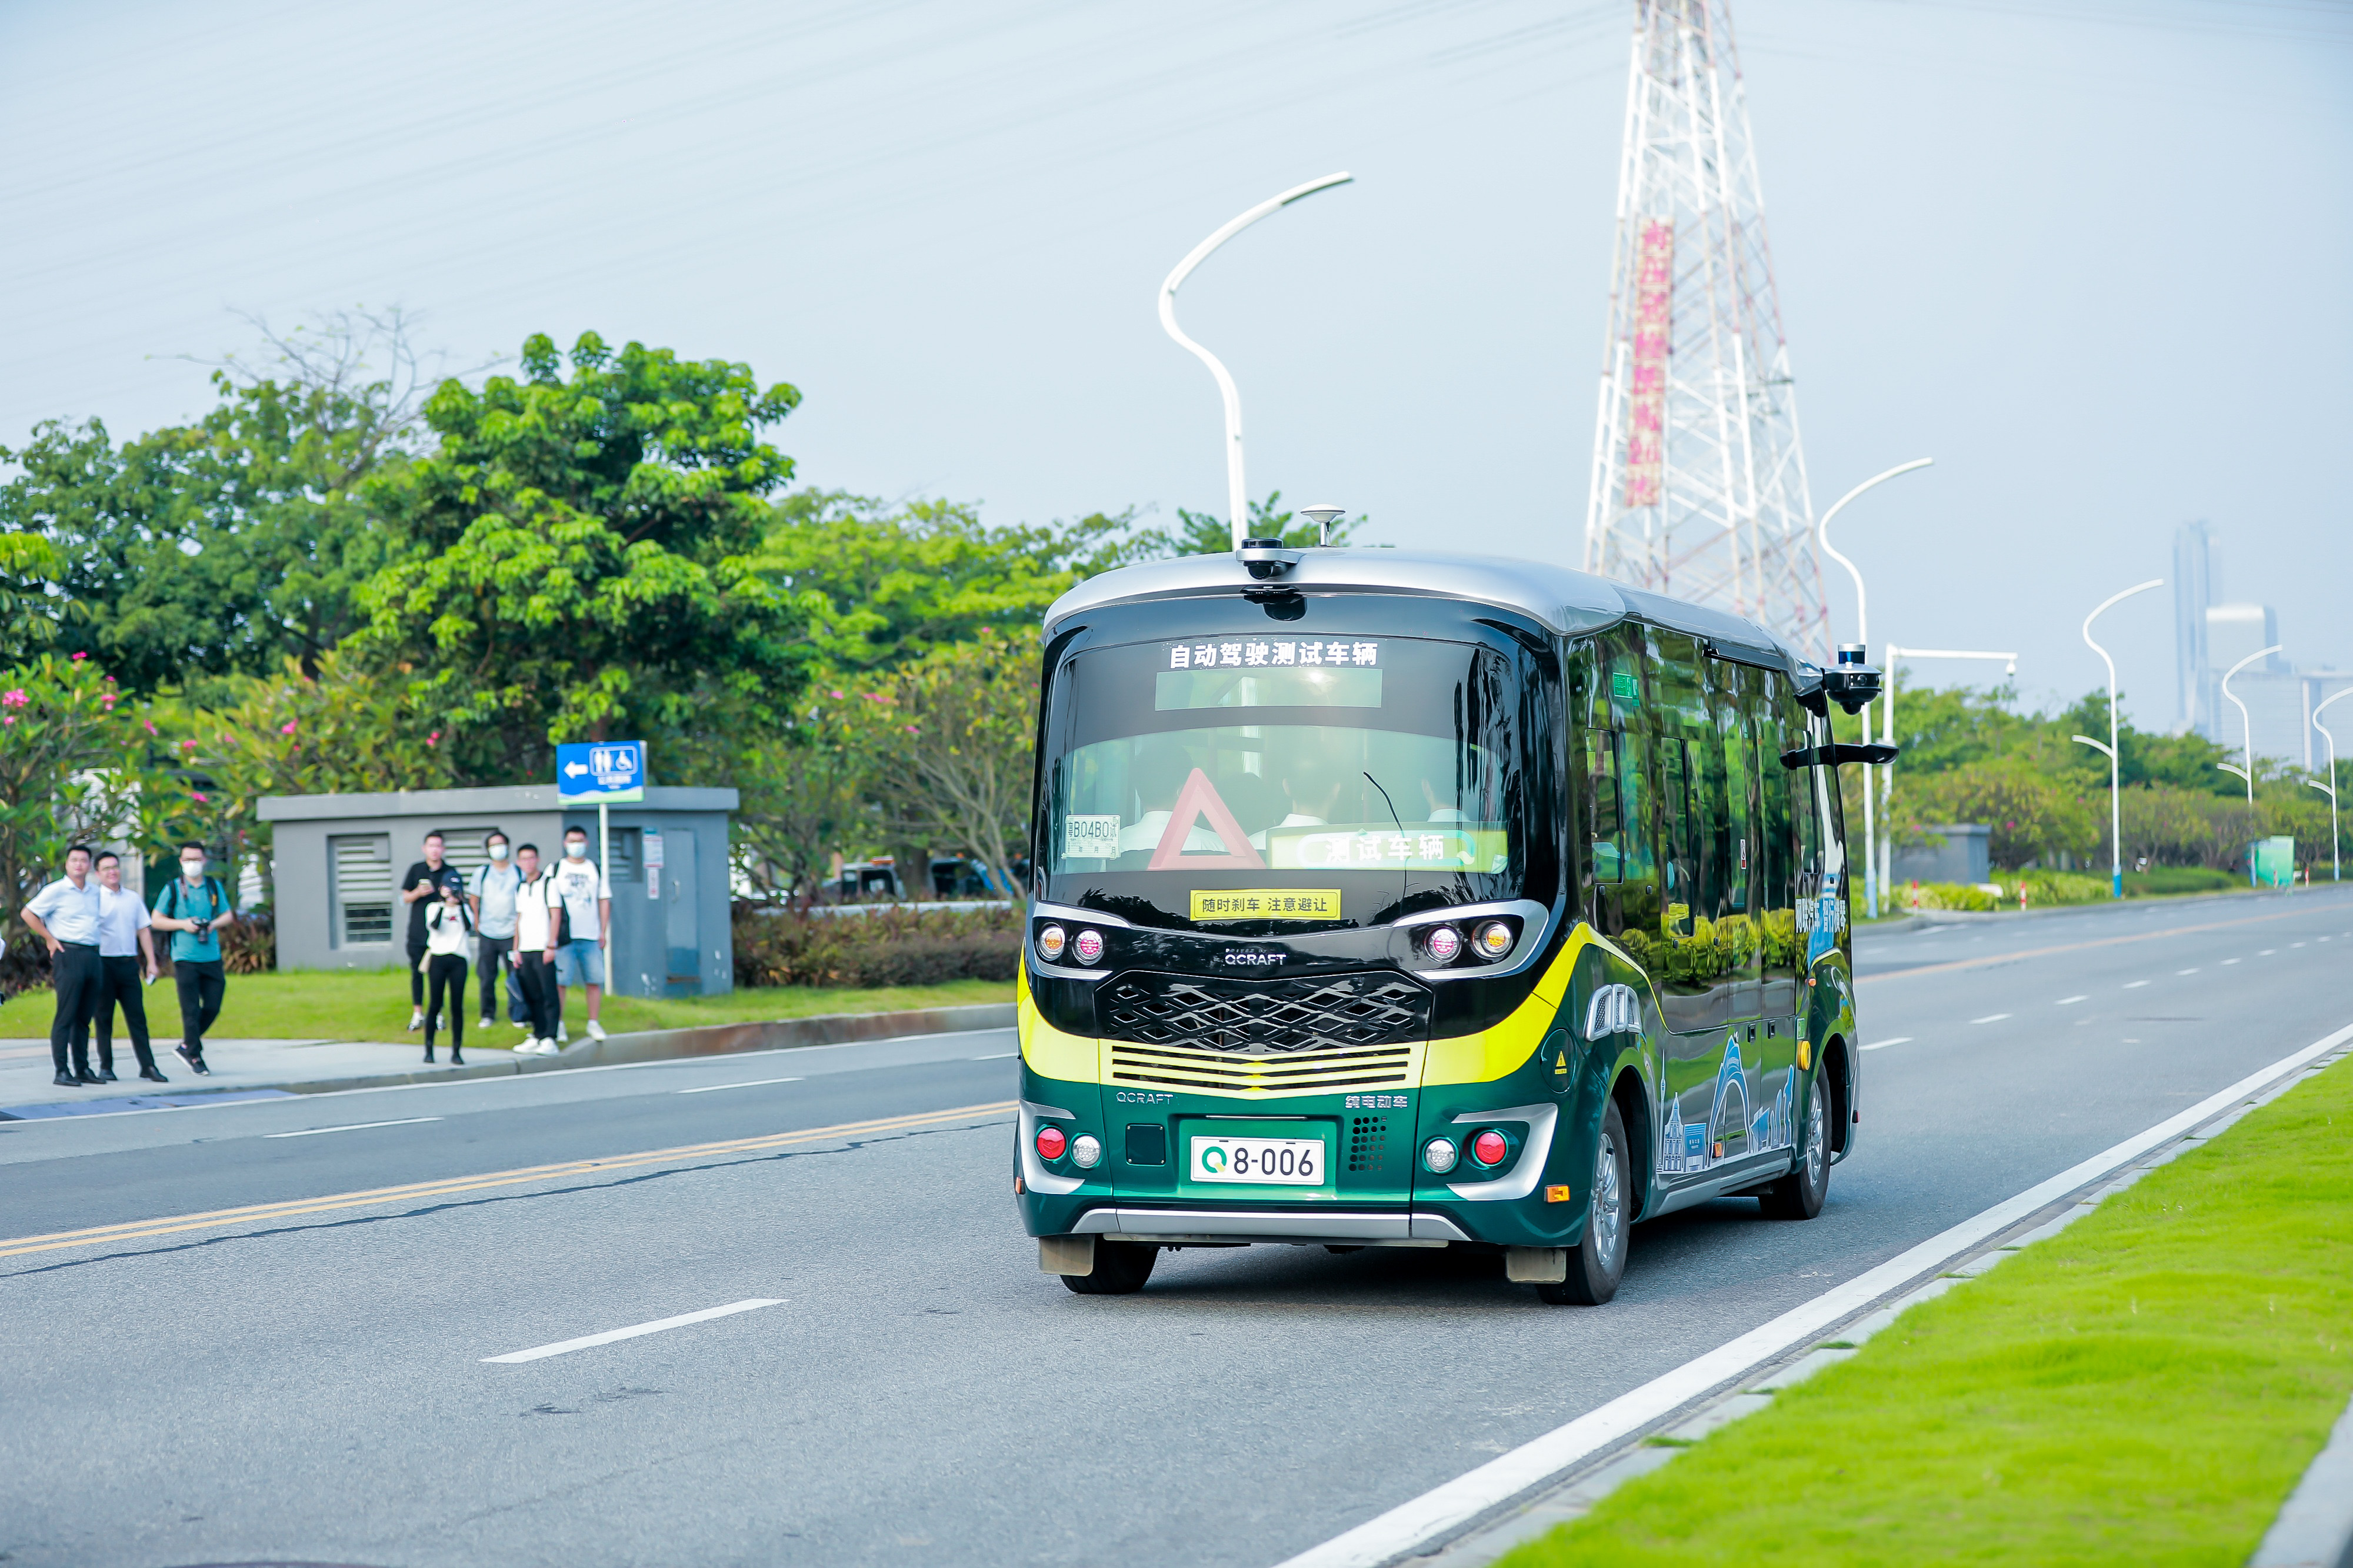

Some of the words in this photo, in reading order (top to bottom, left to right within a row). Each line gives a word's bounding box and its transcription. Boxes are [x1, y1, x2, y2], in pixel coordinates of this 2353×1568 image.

[1169, 641, 1378, 668] 自动驾驶测试车辆
[1325, 833, 1444, 862] 测试车辆
[1202, 898, 1260, 912] 随时刹车
[1268, 898, 1328, 912] 注意避让
[1225, 954, 1287, 965] QCRAFT
[1116, 1092, 1174, 1105] QCRAFT
